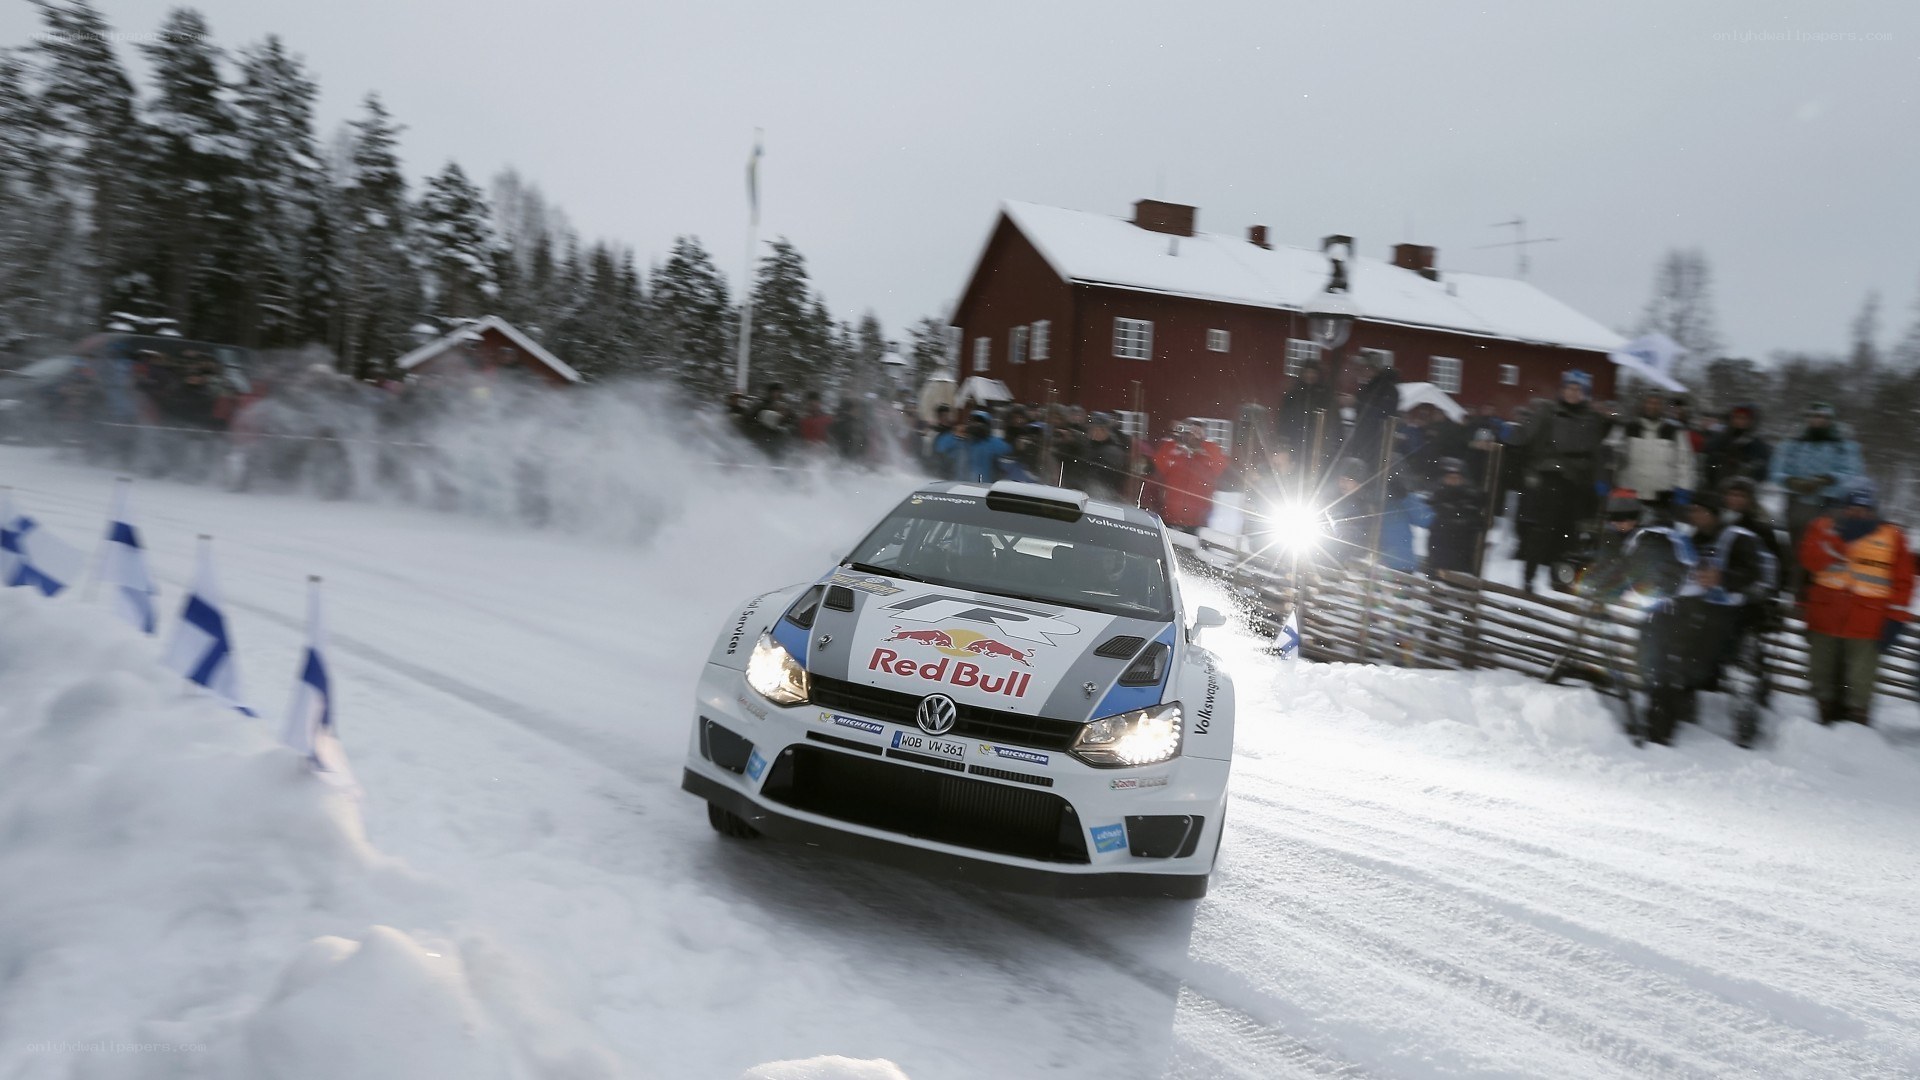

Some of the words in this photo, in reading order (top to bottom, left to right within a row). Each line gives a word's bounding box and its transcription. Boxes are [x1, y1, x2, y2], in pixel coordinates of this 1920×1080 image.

[1086, 516, 1158, 538] Volkswagen
[727, 610, 755, 655] Services
[868, 647, 950, 682] Red
[950, 661, 1031, 698] Bull
[1194, 674, 1220, 735] Volkswagen
[836, 716, 883, 732] MICHELIN
[901, 734, 922, 748] WOB
[928, 739, 943, 752] VW
[942, 744, 964, 756] 361
[999, 749, 1048, 763] MICHELIN
